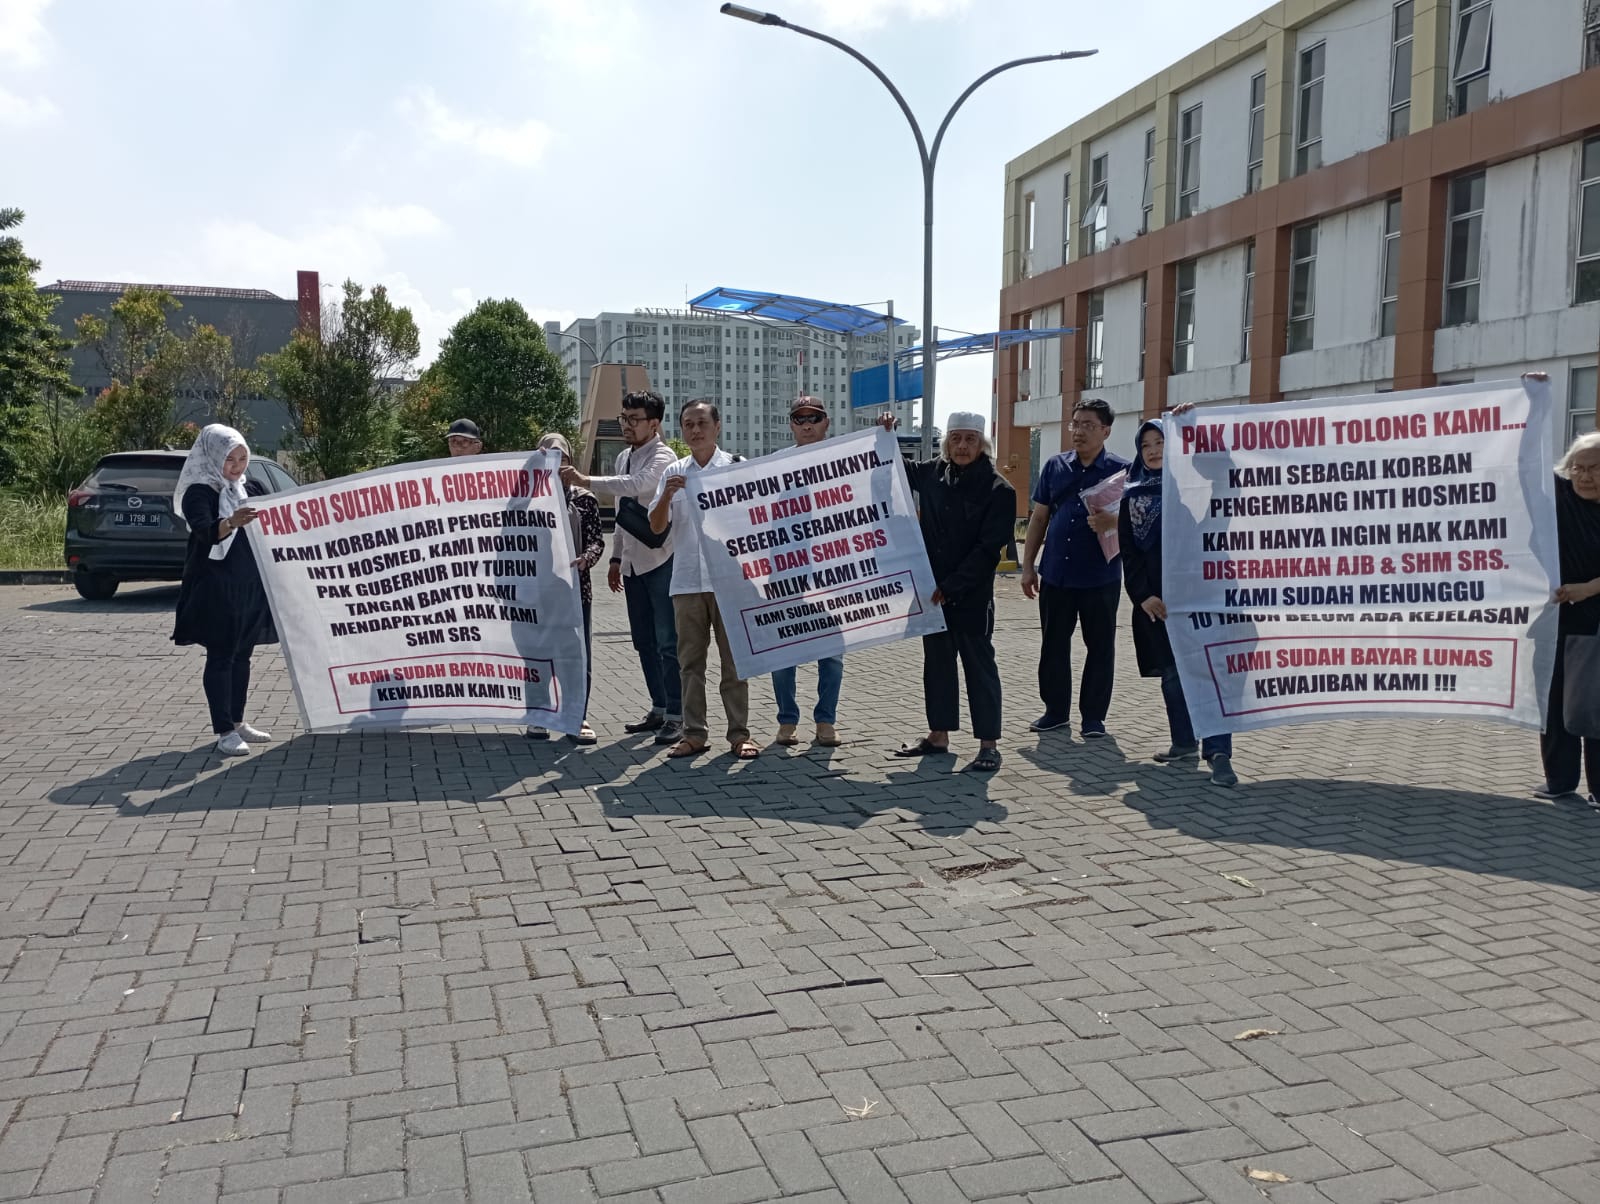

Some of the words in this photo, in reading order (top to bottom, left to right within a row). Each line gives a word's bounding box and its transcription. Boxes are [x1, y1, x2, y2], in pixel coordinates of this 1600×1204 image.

[644, 307, 683, 320] NEXT
[1182, 424, 1225, 455] PAK
[1231, 416, 1325, 451] JOKOWI
[1332, 413, 1426, 444] TOLONG
[697, 476, 780, 510] SIAPAPUN
[783, 450, 893, 490] PEMILIKNYA...
[1229, 465, 1282, 488] KAMI
[1287, 459, 1376, 485] SEBAGAI
[1383, 453, 1473, 479] KORBAN
[258, 504, 298, 536] PAK
[300, 496, 331, 531] SRI
[333, 484, 392, 524] SULTAN
[398, 480, 420, 509] HB
[422, 477, 441, 507] X,
[442, 469, 529, 503] GUBERNUR
[530, 469, 553, 498] DIY
[749, 506, 767, 525] IH
[771, 496, 812, 521] ATAU
[814, 484, 853, 510] MNC
[1210, 491, 1348, 518] PENGEMBANG
[1354, 488, 1395, 510] INTI
[1402, 482, 1496, 507] HOSMED
[272, 542, 322, 562] KAMI
[325, 528, 399, 558] KORBAN
[403, 517, 445, 542] DARI
[449, 511, 557, 533] PENGEMBANG
[727, 528, 790, 557] SEGERA
[792, 504, 880, 541] SERAHKAN
[883, 502, 890, 518] !
[1203, 529, 1254, 551] KAMI
[1260, 526, 1326, 549] HANYA
[1332, 523, 1391, 546] INGIN
[1397, 521, 1441, 544] HAK
[1448, 518, 1507, 541] KAMI
[307, 565, 346, 580] INTI
[349, 549, 426, 578] HOSMED,
[429, 539, 475, 558] KAMI
[478, 535, 538, 554] MOHON
[742, 557, 772, 580] AJB
[775, 549, 809, 572] DAN
[813, 540, 851, 563] SHM
[852, 529, 887, 553] SRS
[1203, 556, 1331, 580] DISERAHKAN
[1336, 555, 1374, 577] AJB
[1381, 556, 1396, 574] &
[1402, 551, 1451, 573] SHM
[1458, 549, 1509, 571] SRS.
[316, 584, 352, 598] PAK
[355, 565, 449, 597] GUBERNUR
[452, 562, 480, 578] DIY
[482, 560, 536, 577] TURUN
[764, 574, 812, 600] MILIK
[814, 563, 858, 587] KAMI
[860, 557, 878, 576] !!!
[1224, 587, 1277, 607] KAMI
[1283, 585, 1354, 606] SUDAH
[1360, 581, 1484, 604] MENUNGGU
[345, 595, 415, 617] TANGAN
[418, 584, 474, 610] BANTU
[477, 583, 516, 600] KAMI
[755, 609, 786, 627] KAMI
[788, 602, 825, 620] SUDAH
[827, 592, 864, 611] BAYAR
[866, 581, 904, 601] LUNAS
[331, 608, 457, 637] MENDAPATKAN
[463, 605, 496, 620] HAK
[499, 605, 537, 624] KAMI
[778, 616, 842, 639] KEWAJIBAN
[845, 608, 875, 624] KAMI
[877, 604, 890, 615] !!!
[1188, 612, 1212, 630] 10
[1409, 606, 1529, 625] KEJELASAN
[406, 628, 445, 647] SHM
[448, 626, 481, 642] SRS
[348, 670, 392, 686] KAMI
[395, 663, 446, 682] SUDAH
[449, 664, 495, 677] BAYAR
[498, 666, 540, 683] LUNAS
[1226, 653, 1271, 674] KAMI
[1277, 648, 1345, 668] SUDAH
[1351, 649, 1416, 666] BAYAR
[1423, 649, 1493, 667] LUNAS
[377, 684, 465, 702] KEWAJIBAN
[468, 683, 505, 698] KAMI
[508, 686, 521, 701] !!!
[1255, 674, 1368, 698] KEWAJIBAN
[1373, 673, 1428, 692] KAMI
[1434, 674, 1456, 692] !!!
